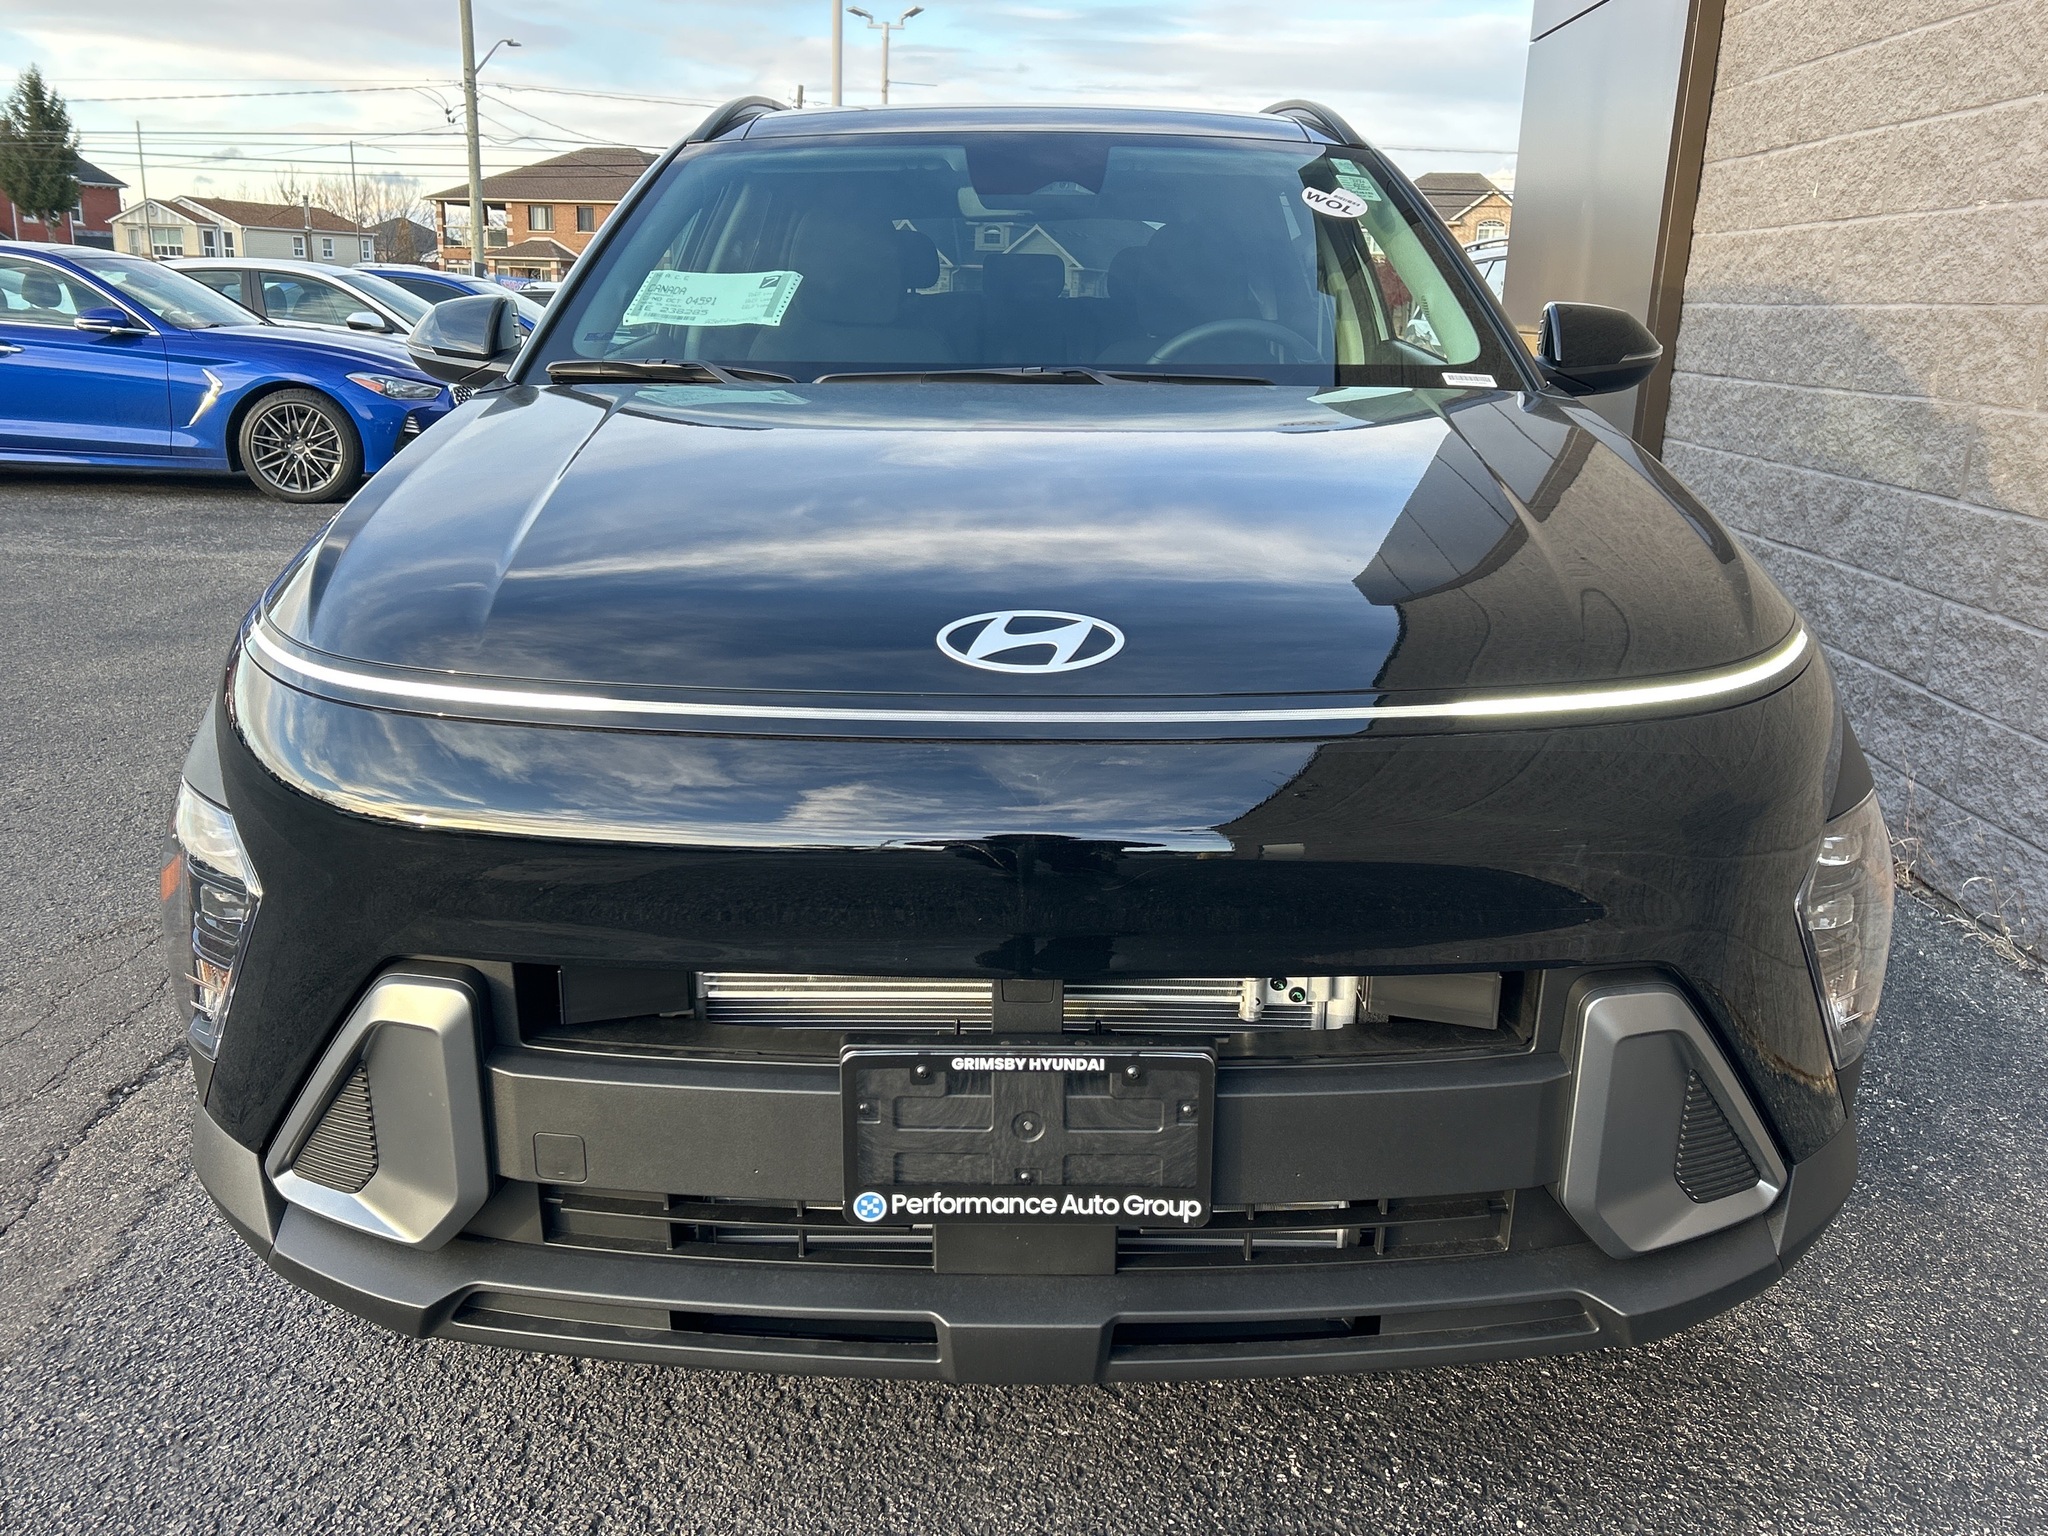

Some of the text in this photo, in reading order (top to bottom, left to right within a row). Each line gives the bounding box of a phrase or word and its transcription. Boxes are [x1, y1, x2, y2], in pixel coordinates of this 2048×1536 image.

[1306, 191, 1353, 215] WOL
[648, 284, 687, 295] CANADA
[685, 296, 717, 305] 04591
[951, 1057, 1105, 1072] GRIMSBY HYUNDAI
[891, 1192, 1202, 1223] Performance Auto Group
